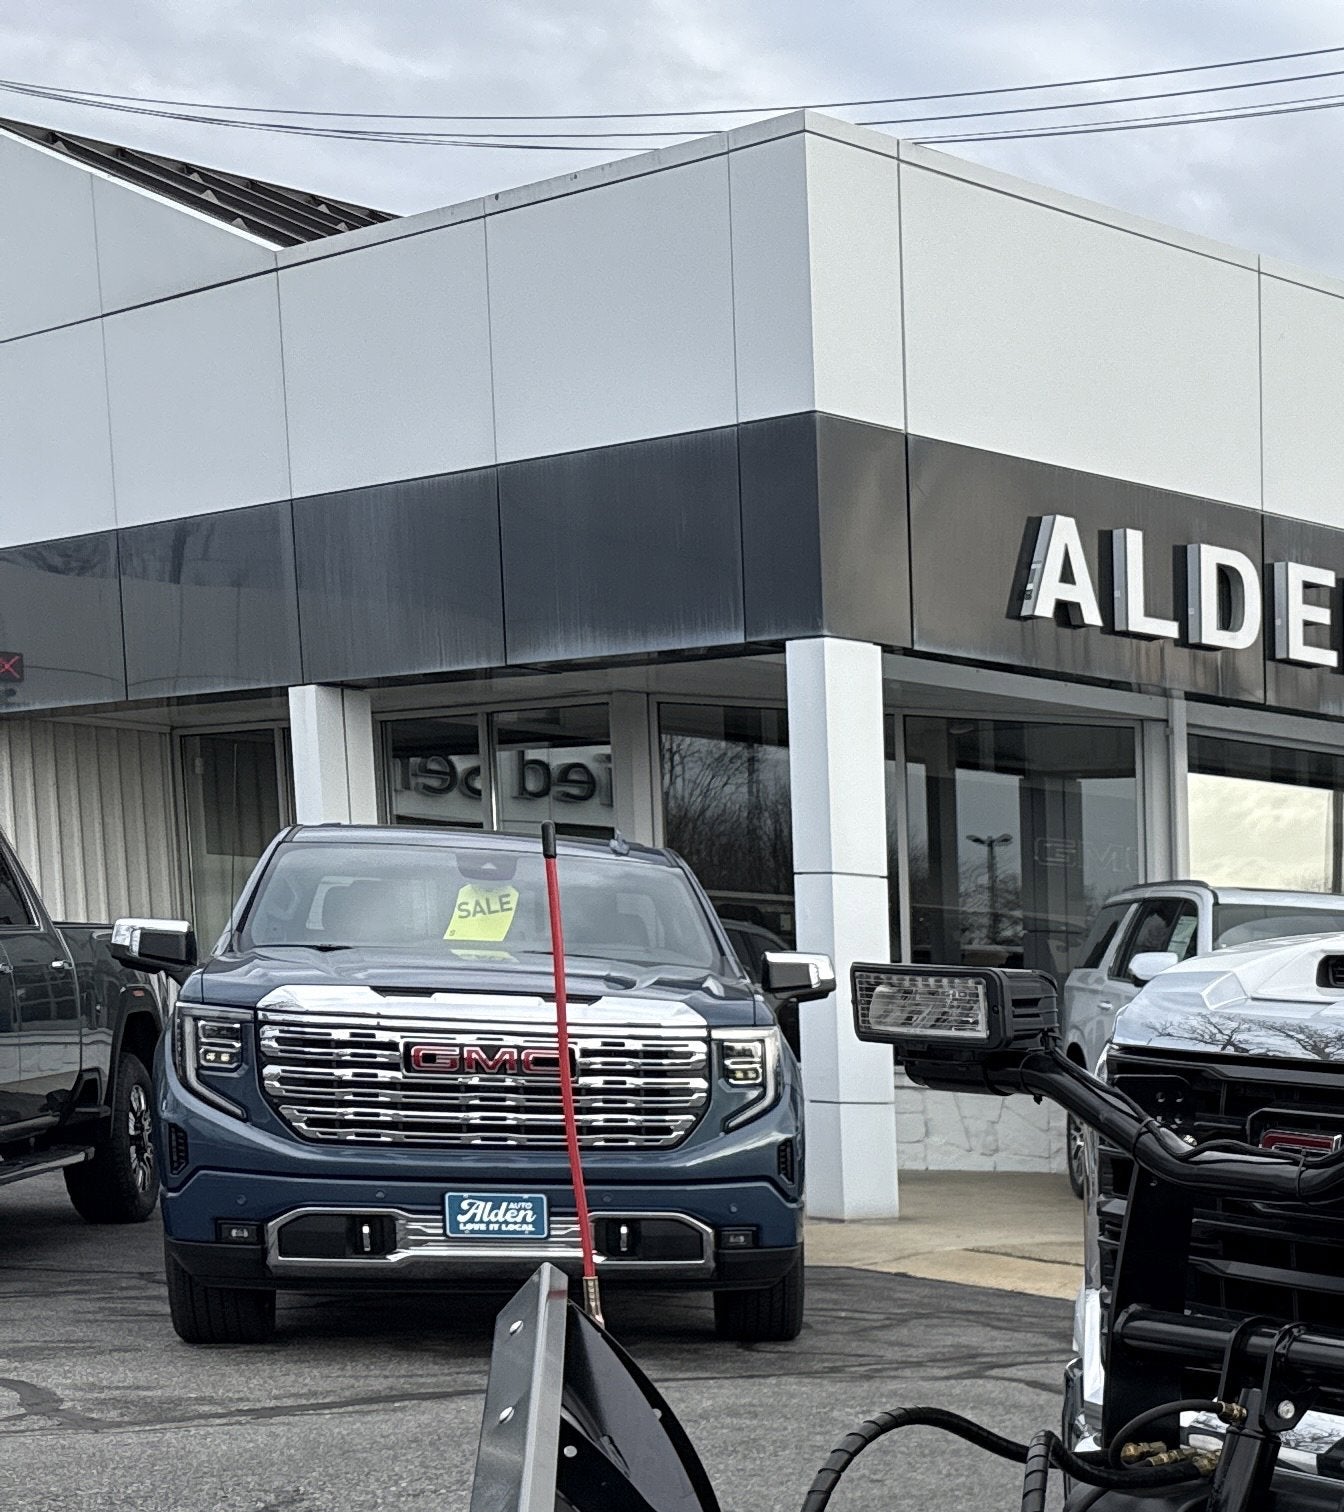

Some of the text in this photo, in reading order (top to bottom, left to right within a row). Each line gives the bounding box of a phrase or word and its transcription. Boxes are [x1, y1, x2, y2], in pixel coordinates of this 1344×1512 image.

[457, 893, 513, 919] SALE
[411, 1045, 564, 1074] GMC
[456, 1199, 537, 1223] Alden
[507, 1201, 533, 1210] AUTO
[459, 1222, 535, 1232] LOVE IT LOCAL
